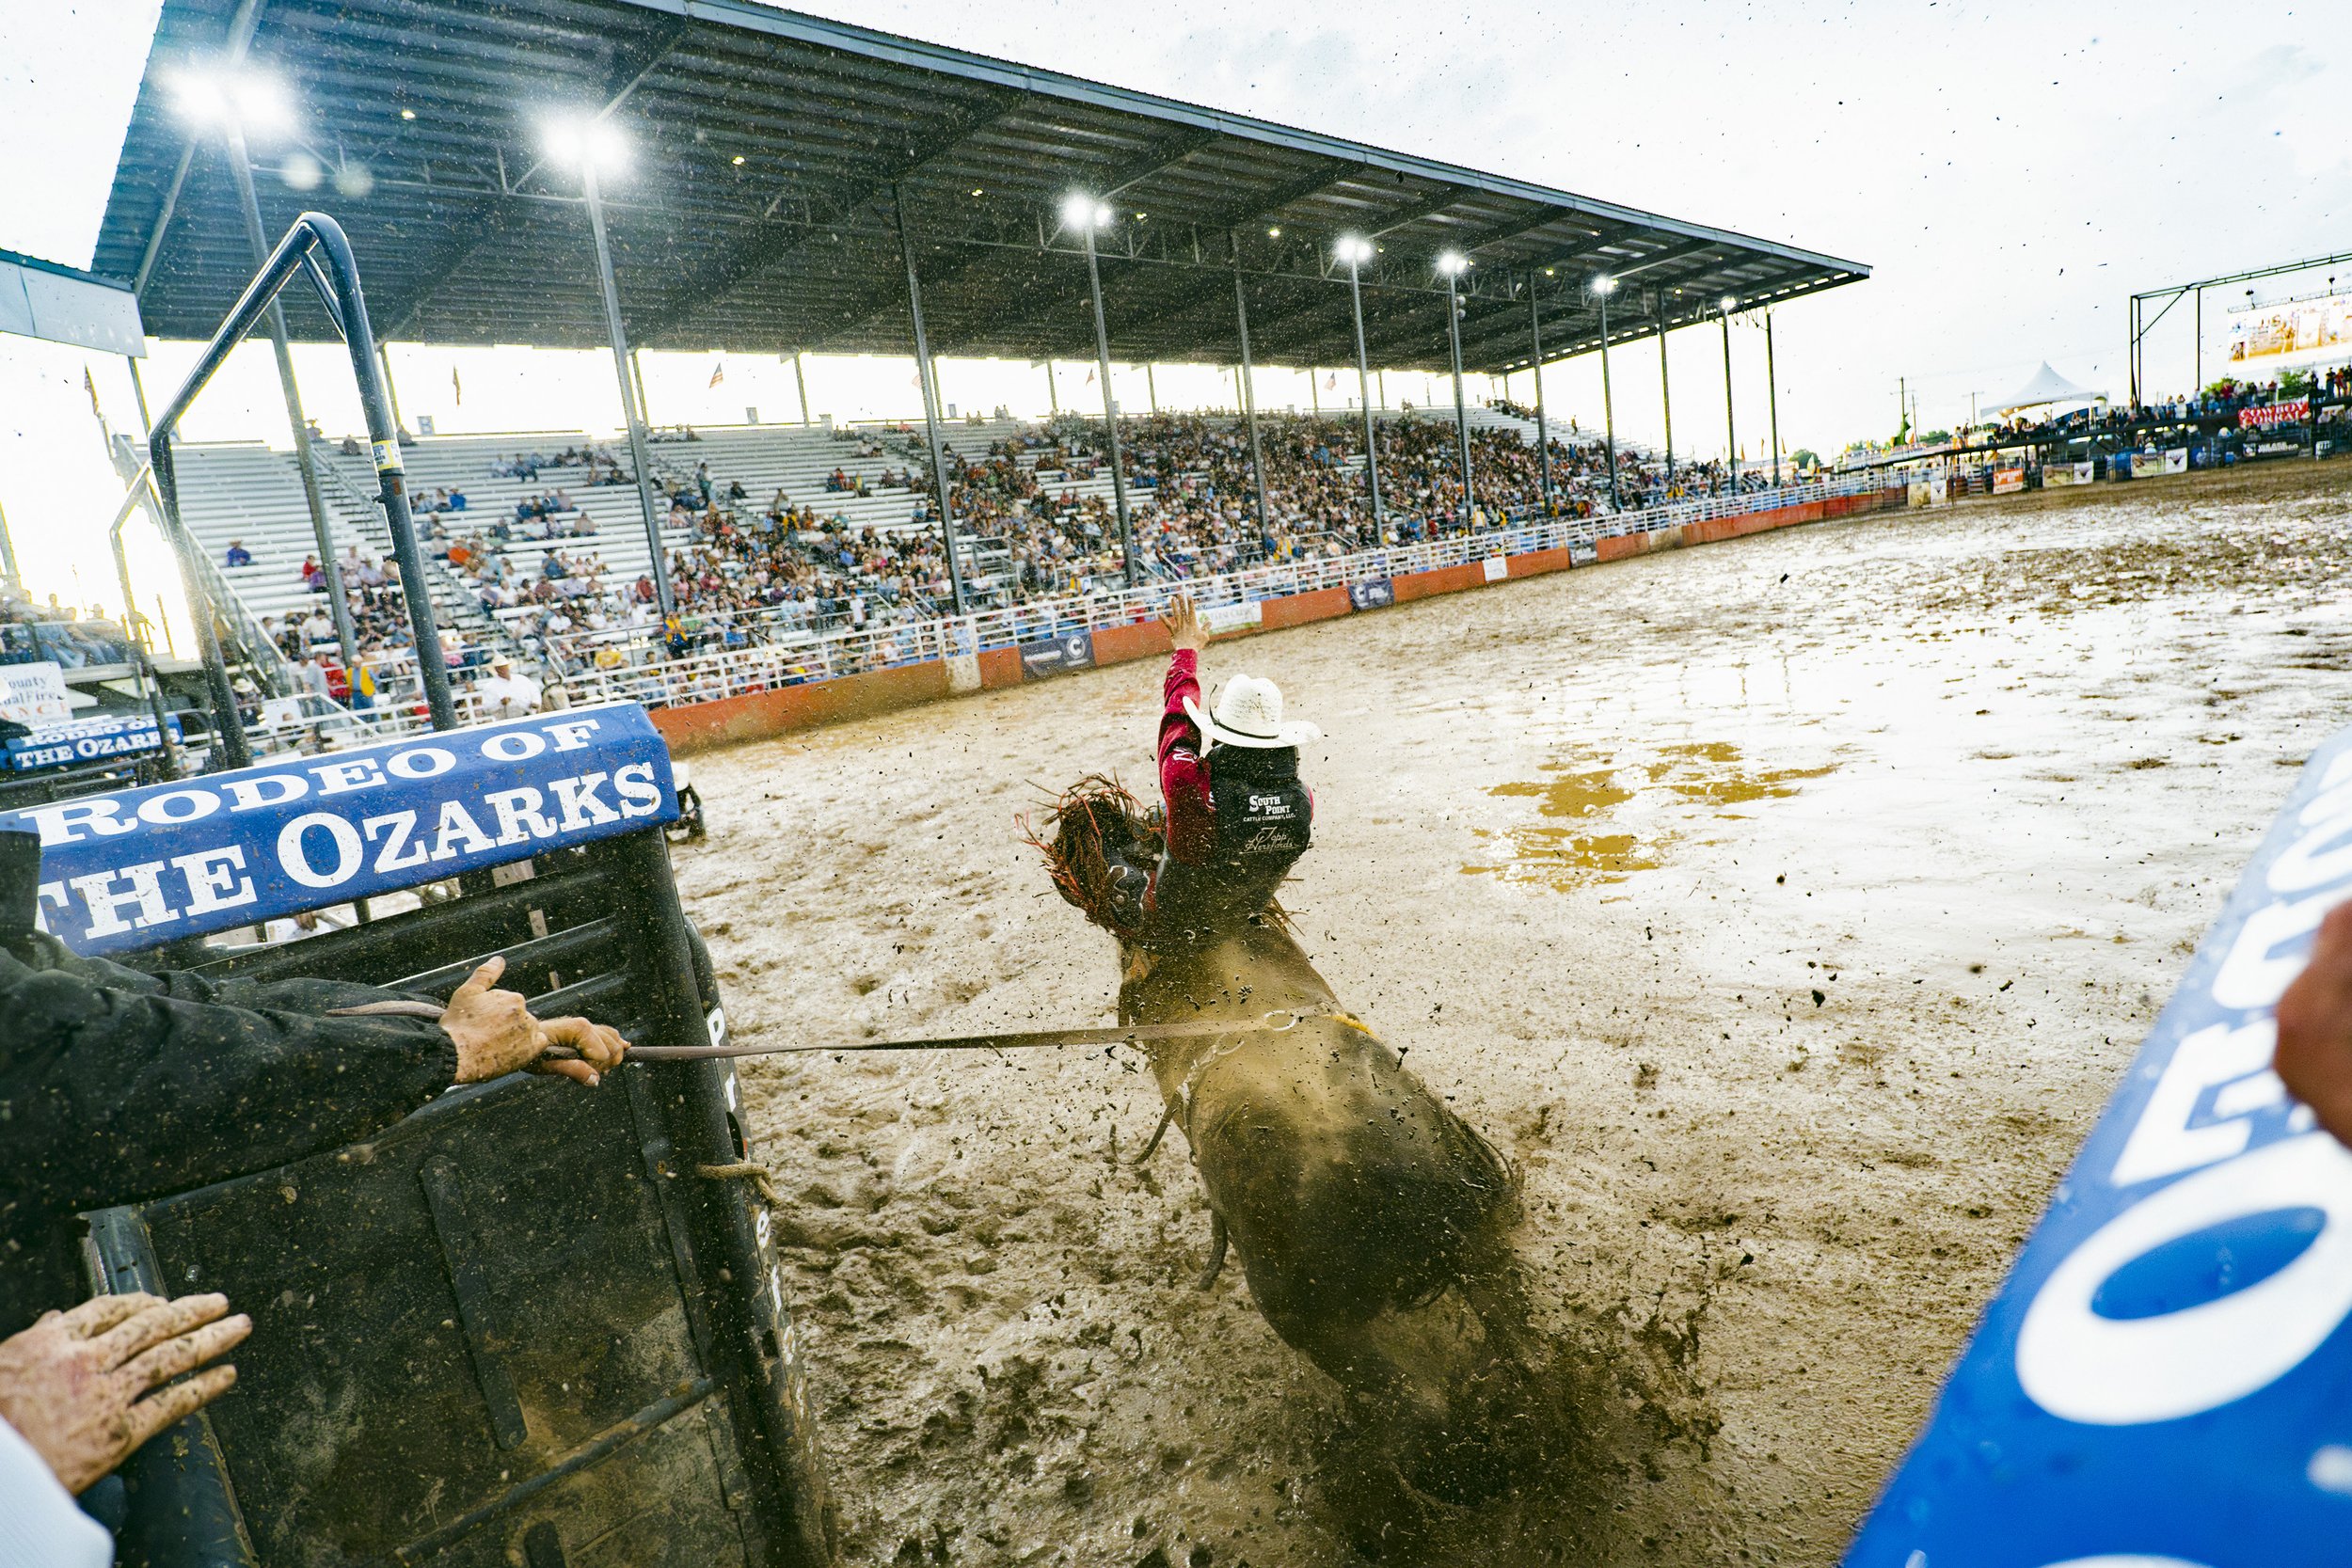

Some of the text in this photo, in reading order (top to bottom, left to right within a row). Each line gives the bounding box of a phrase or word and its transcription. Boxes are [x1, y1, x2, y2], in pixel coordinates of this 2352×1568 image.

[7, 676, 47, 690] ounty
[15, 727, 181, 768] THE OZARKS
[19, 719, 601, 847] RODEO OF
[35, 761, 662, 943] THE OZARKS
